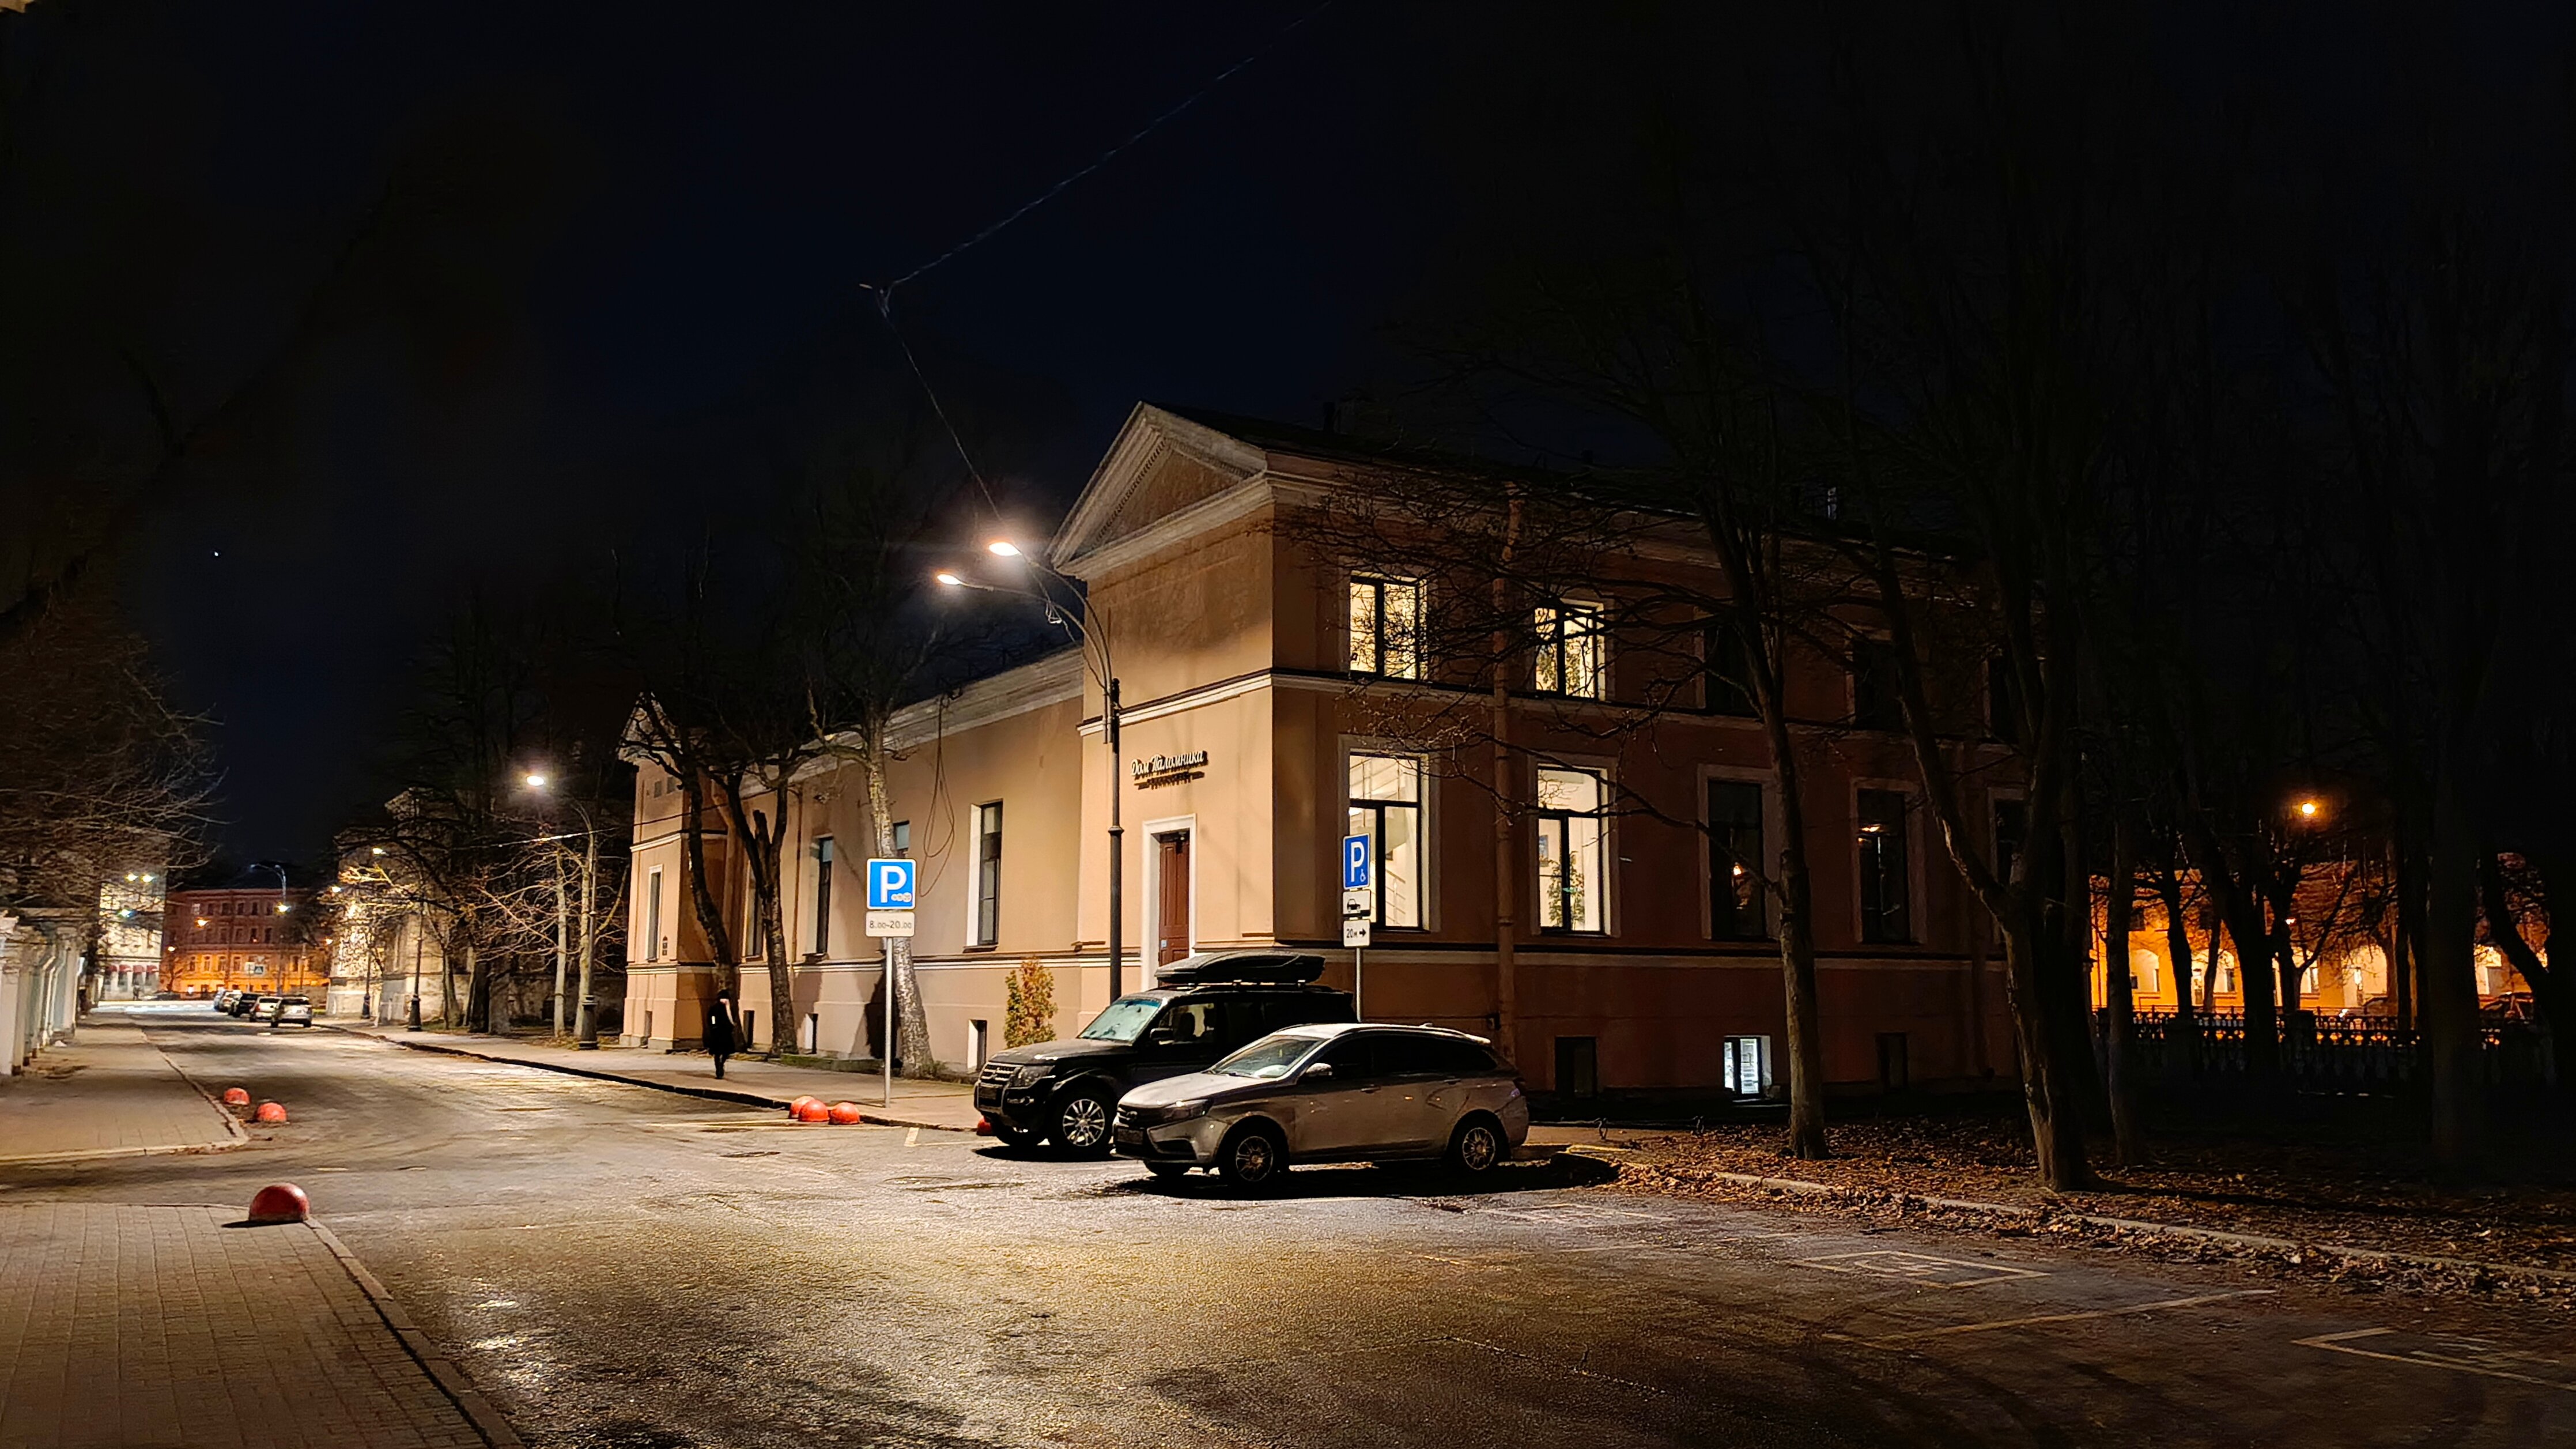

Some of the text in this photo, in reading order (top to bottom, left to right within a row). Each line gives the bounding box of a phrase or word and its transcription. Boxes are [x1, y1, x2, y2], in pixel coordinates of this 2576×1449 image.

[1130, 759, 1150, 775] Дом
[1351, 841, 1365, 882] P
[881, 866, 908, 903] P
